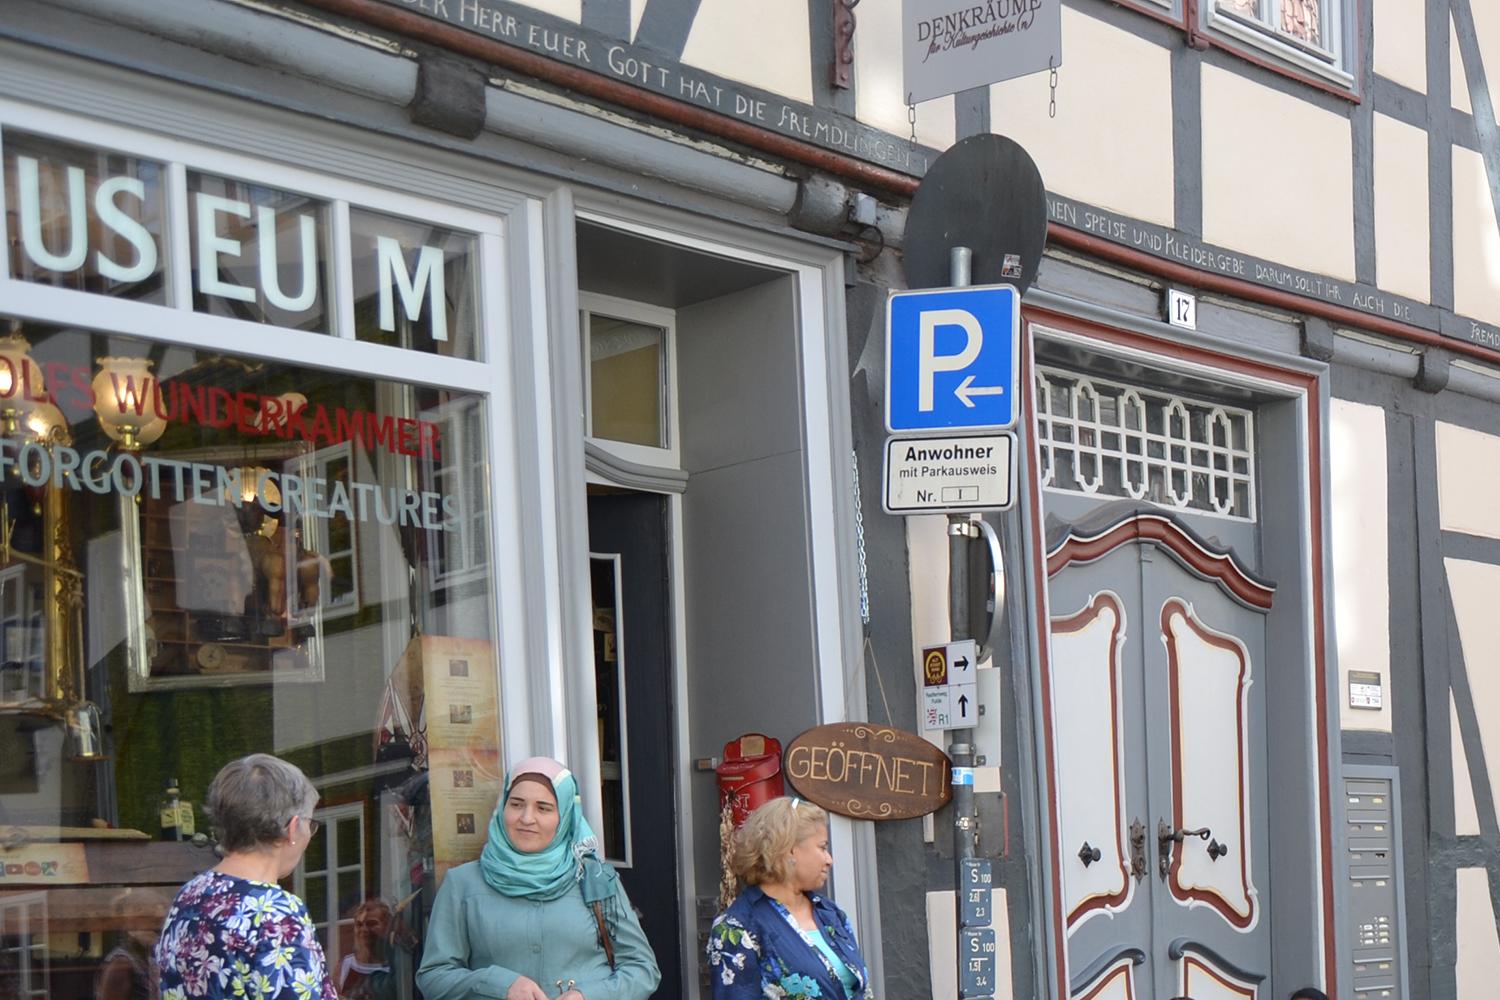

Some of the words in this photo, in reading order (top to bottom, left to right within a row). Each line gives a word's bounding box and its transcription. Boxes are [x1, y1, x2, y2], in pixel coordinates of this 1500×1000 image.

[460, 0, 518, 38] HERR
[529, 25, 590, 63] EUER
[608, 46, 670, 88] GOTT
[680, 76, 723, 106] HAT
[736, 94, 766, 121] DIE
[1047, 199, 1077, 225] NEN
[1085, 212, 1127, 240] SPEISE
[1133, 228, 1162, 251] UND
[1255, 263, 1293, 287] DARUM
[1353, 292, 1384, 313] AUCH
[1176, 297, 1190, 322] 17
[918, 309, 983, 412] P
[110, 372, 441, 460] WUNDERKAMMER
[900, 467, 918, 478] mit
[921, 464, 998, 478] Parkausweis
[905, 445, 994, 461] Anwohner
[0, 438, 243, 509] FORGOTTEN
[257, 469, 464, 533] CREATURES
[917, 489, 937, 503] Nr.
[788, 741, 934, 797] GEÖFFNET
[971, 868, 979, 883] S
[981, 873, 992, 884] 100
[970, 937, 979, 952] S
[982, 942, 994, 952] 100
